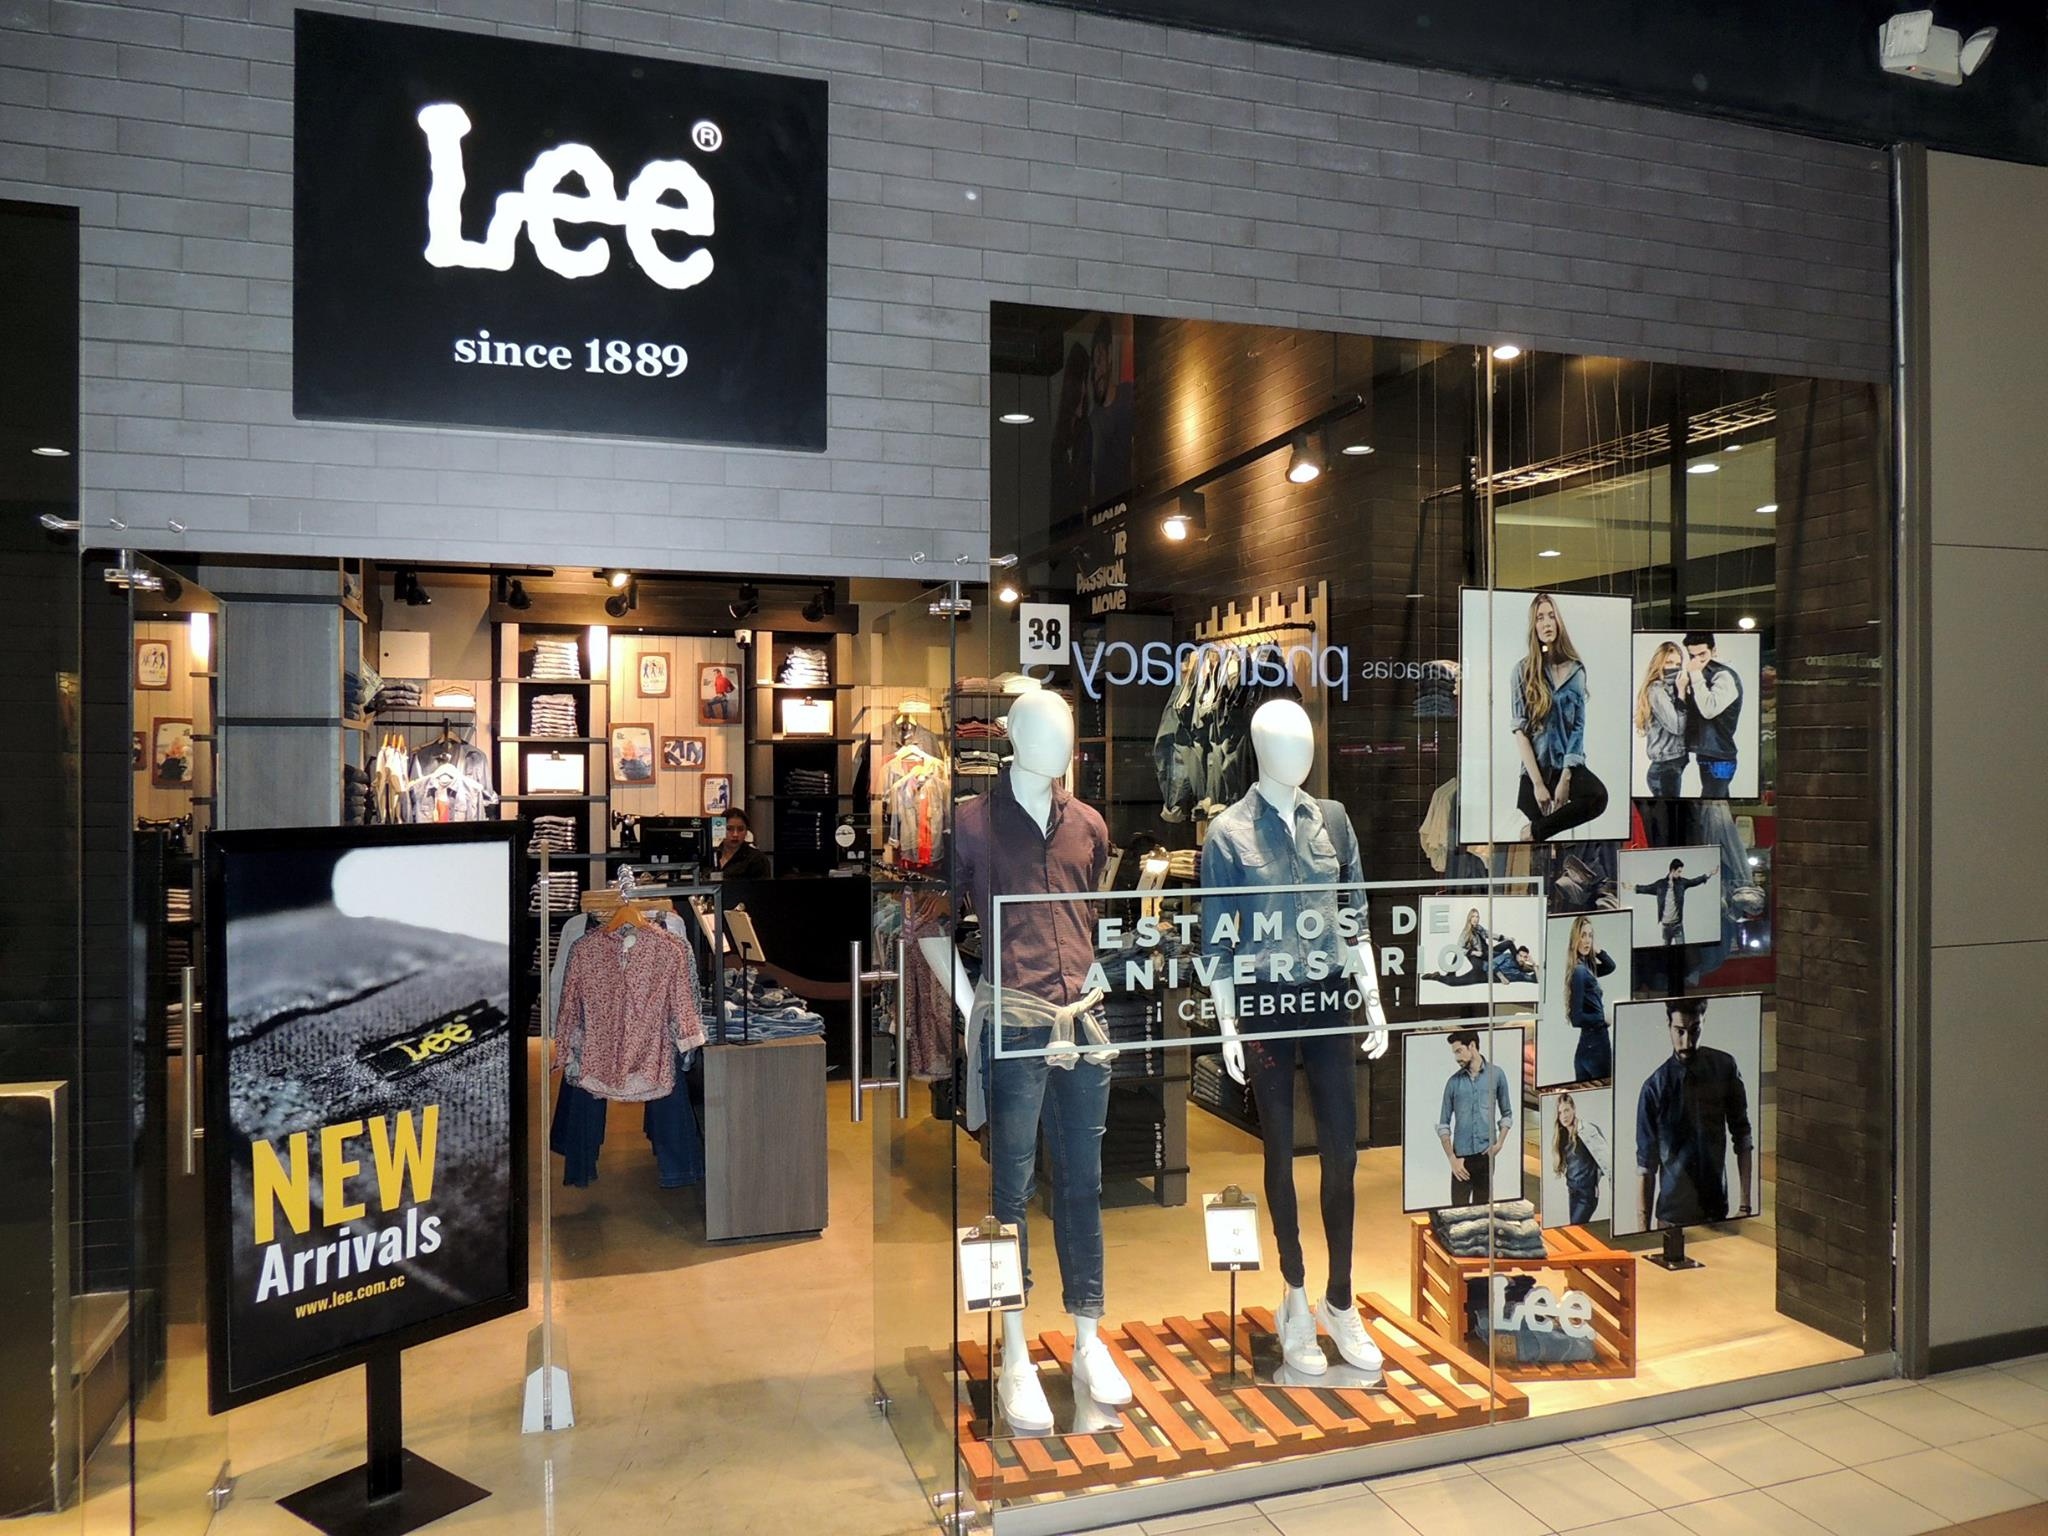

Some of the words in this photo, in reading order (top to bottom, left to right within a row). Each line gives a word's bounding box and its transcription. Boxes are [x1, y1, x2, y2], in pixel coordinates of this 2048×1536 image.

[417, 103, 715, 290] Lee
[454, 329, 573, 370] since
[584, 338, 689, 378] 1889
[1028, 617, 1062, 650] 38
[1098, 907, 1360, 950] ESTAMOS
[1392, 904, 1450, 935] DE
[1081, 943, 1465, 995] ANIVERSARIO
[1178, 988, 1381, 1022] CEEBREMOS
[399, 1023, 473, 1062] Lee
[252, 1104, 439, 1245] NEW
[255, 1207, 442, 1303] Arrivals
[295, 1274, 406, 1319] www.lee.com.ec
[1490, 1273, 1597, 1341] Lee
